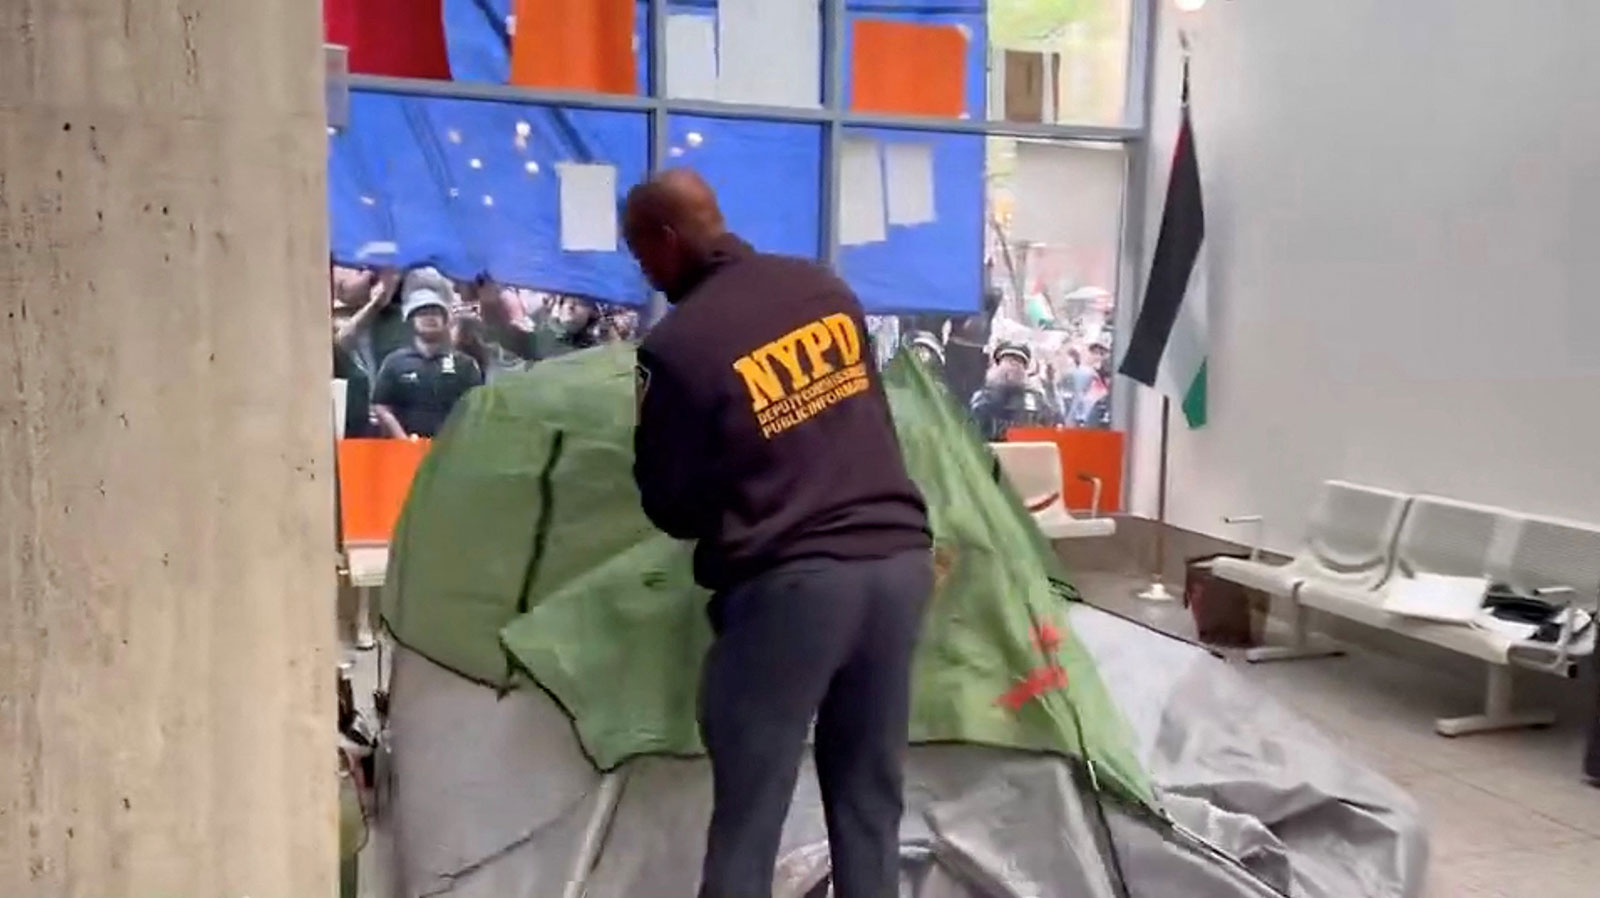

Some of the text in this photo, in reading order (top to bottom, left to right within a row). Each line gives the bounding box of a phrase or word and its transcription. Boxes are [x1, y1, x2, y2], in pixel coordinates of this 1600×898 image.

[733, 312, 861, 412] NYPD
[757, 393, 803, 425] DEPUTY
[762, 406, 811, 439] PUBLIC
